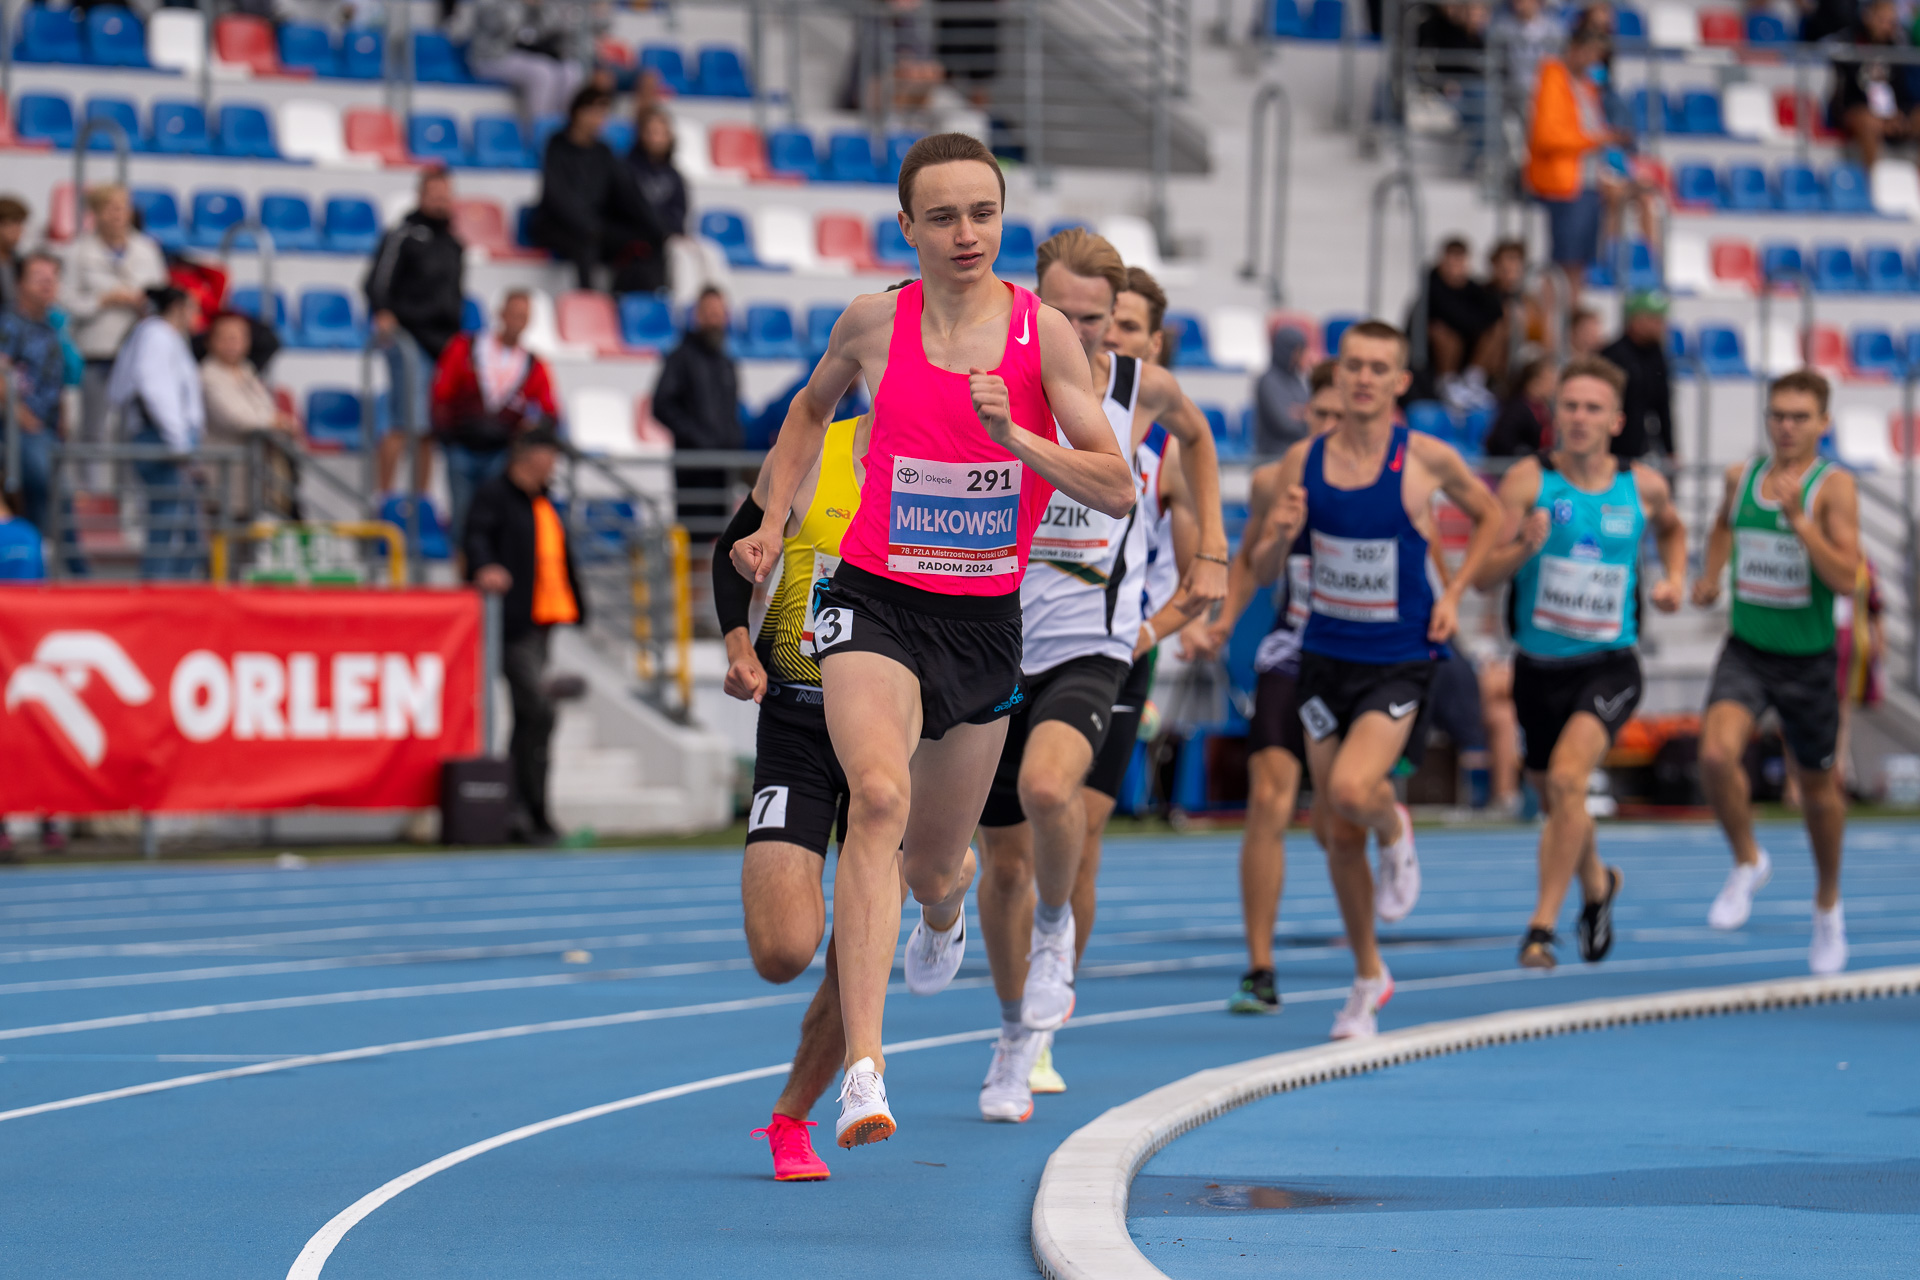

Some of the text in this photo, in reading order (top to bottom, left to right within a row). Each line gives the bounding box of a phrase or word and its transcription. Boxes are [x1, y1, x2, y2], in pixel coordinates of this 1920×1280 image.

[925, 474, 952, 485] Okęcie
[966, 468, 1011, 492] 291
[826, 507, 850, 520] esa
[896, 505, 1013, 536] MIŁKOWSKI
[901, 547, 1008, 560] 78. PZLA Mistrzostwa Polski U20
[918, 561, 993, 573] RADOM 2024
[821, 608, 842, 645] 3
[169, 649, 445, 743] ORLEN
[796, 690, 825, 705] NI
[757, 789, 778, 826] 7
